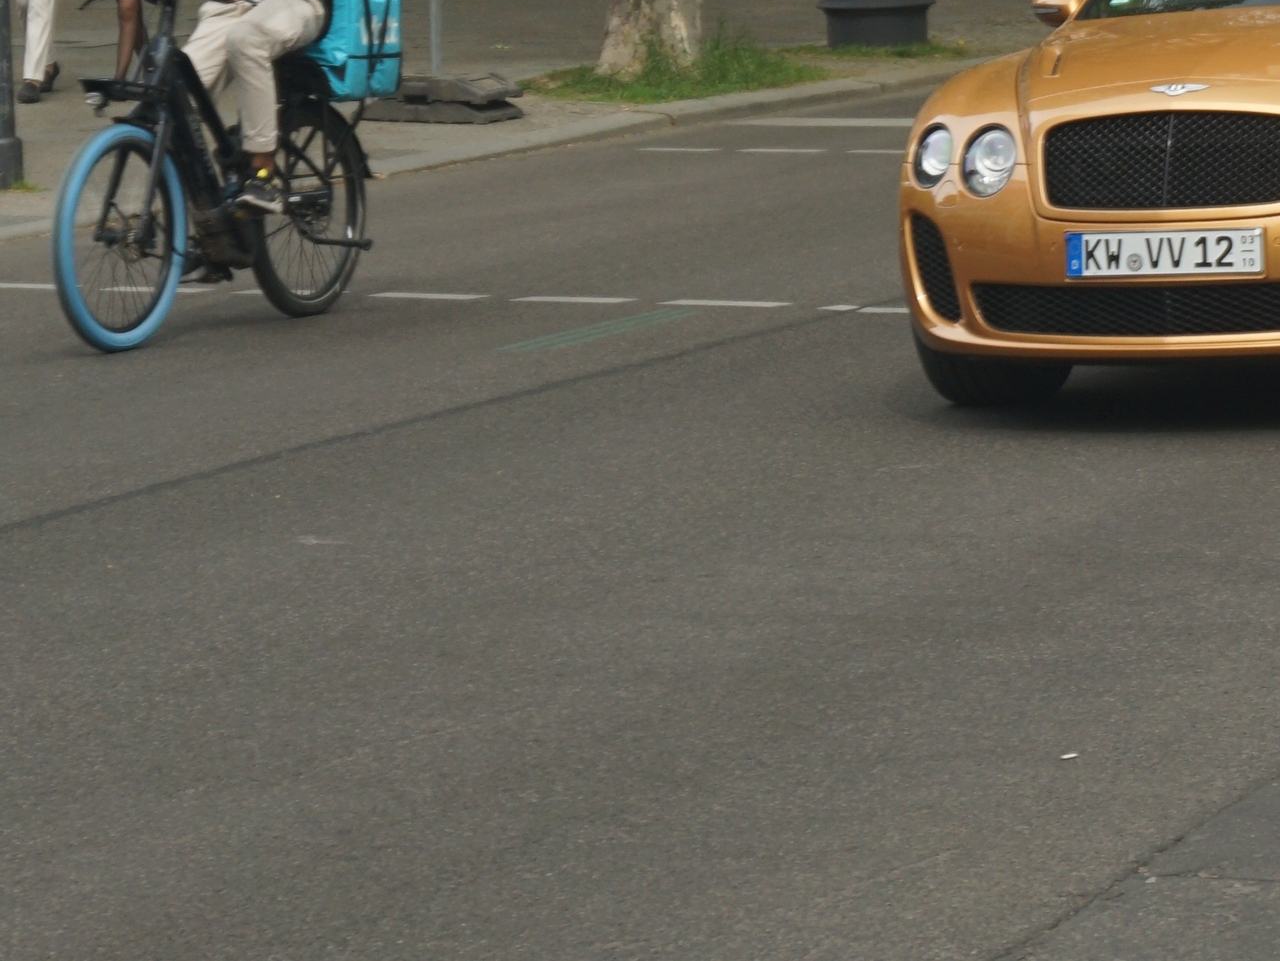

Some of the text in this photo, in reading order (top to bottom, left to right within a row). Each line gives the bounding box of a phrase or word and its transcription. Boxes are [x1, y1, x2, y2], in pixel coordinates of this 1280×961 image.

[1240, 234, 1255, 244] 03
[1084, 235, 1234, 271] KW VV 12
